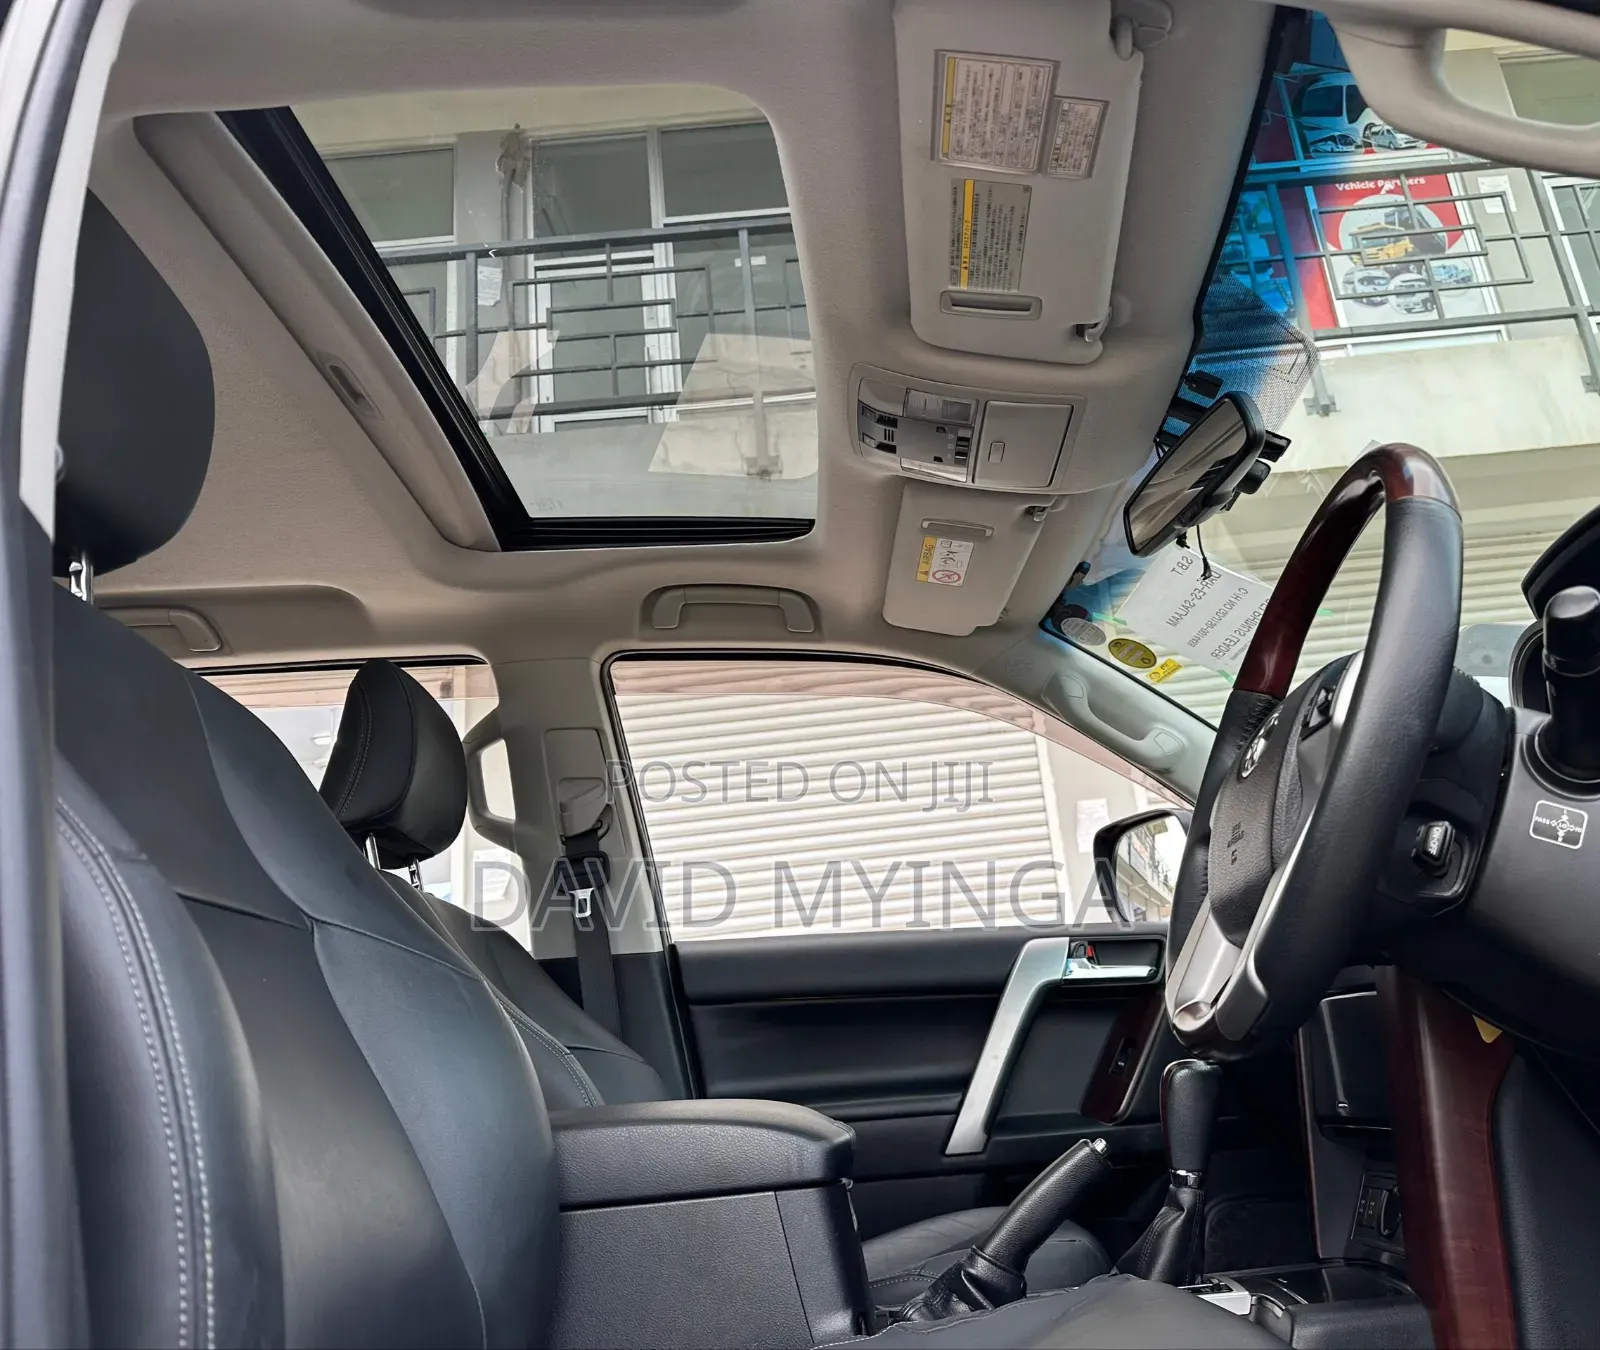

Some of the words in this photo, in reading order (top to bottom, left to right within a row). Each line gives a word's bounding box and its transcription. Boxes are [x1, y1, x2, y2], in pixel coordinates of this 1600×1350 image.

[1335, 180, 1376, 191] Vehicle
[1377, 177, 1426, 189] Parters
[921, 544, 934, 565] AIRBAG
[1535, 816, 1550, 825] PASS
